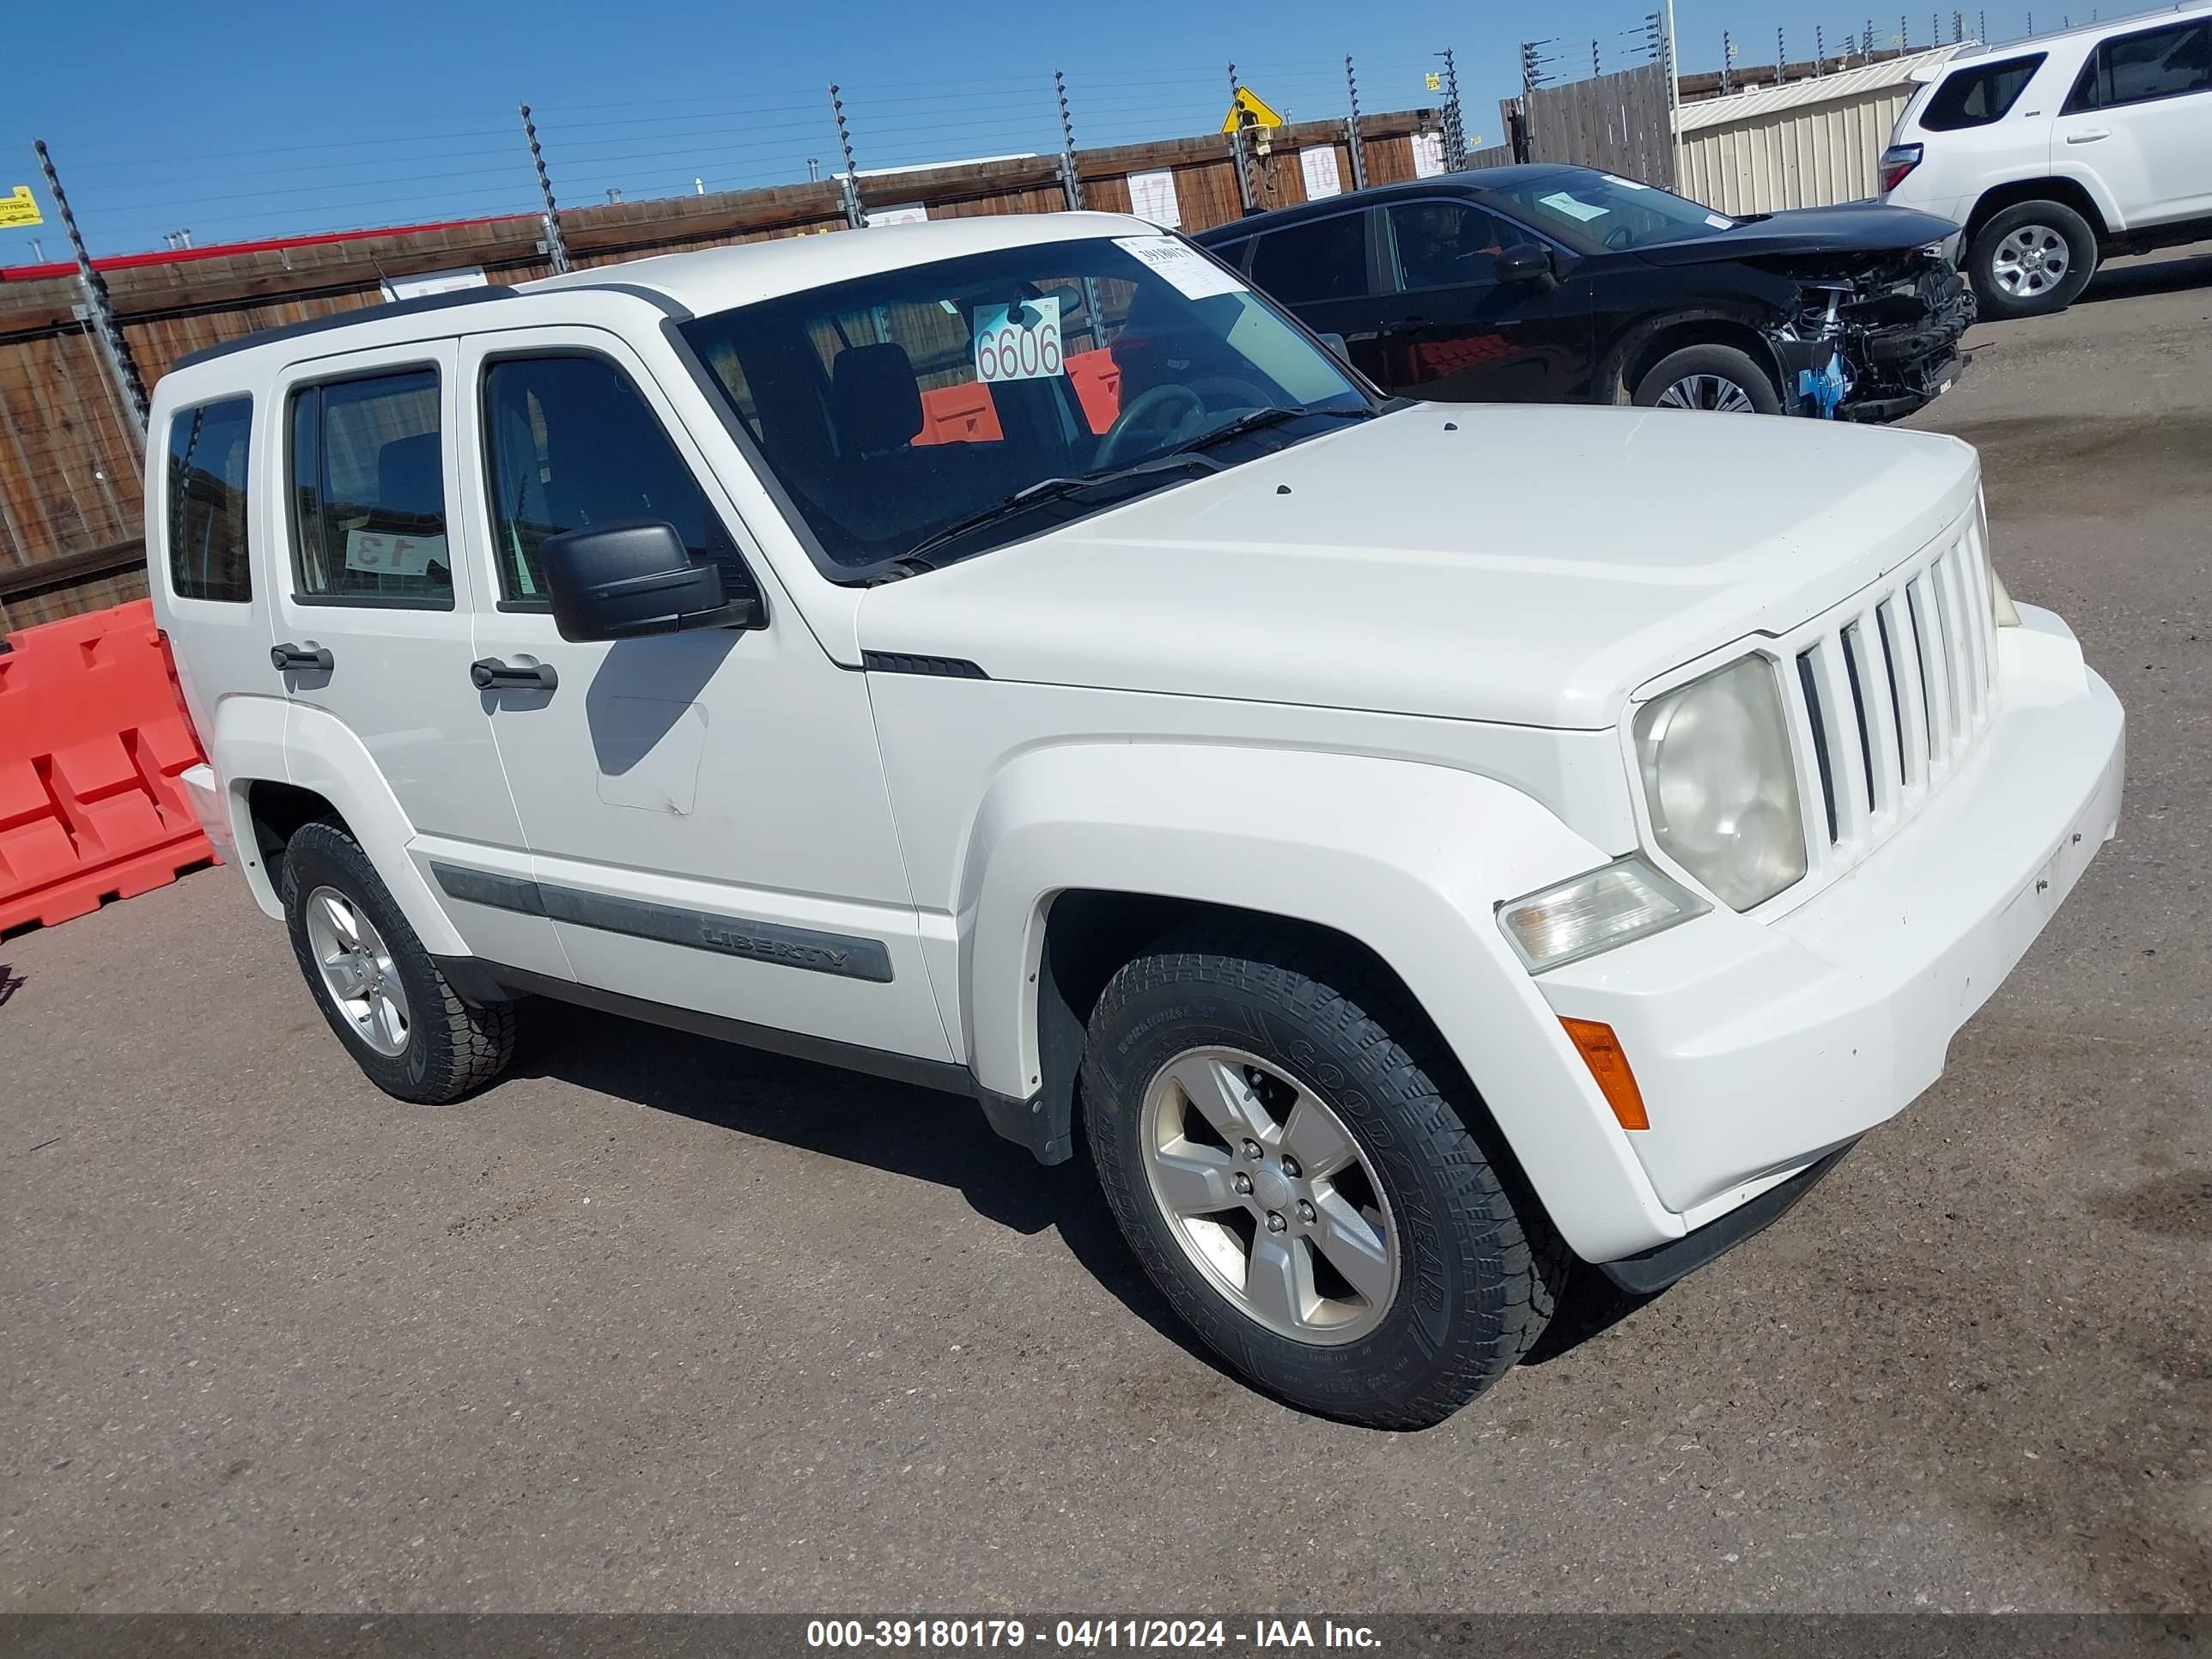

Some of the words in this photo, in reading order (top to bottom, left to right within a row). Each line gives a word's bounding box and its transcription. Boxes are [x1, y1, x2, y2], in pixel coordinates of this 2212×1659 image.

[1310, 152, 1334, 189] 18
[1139, 178, 1167, 220] 17
[978, 324, 1060, 380] 6606
[702, 927, 848, 967] LIBERTY
[1288, 1039, 1446, 1314] GOODYEAR
